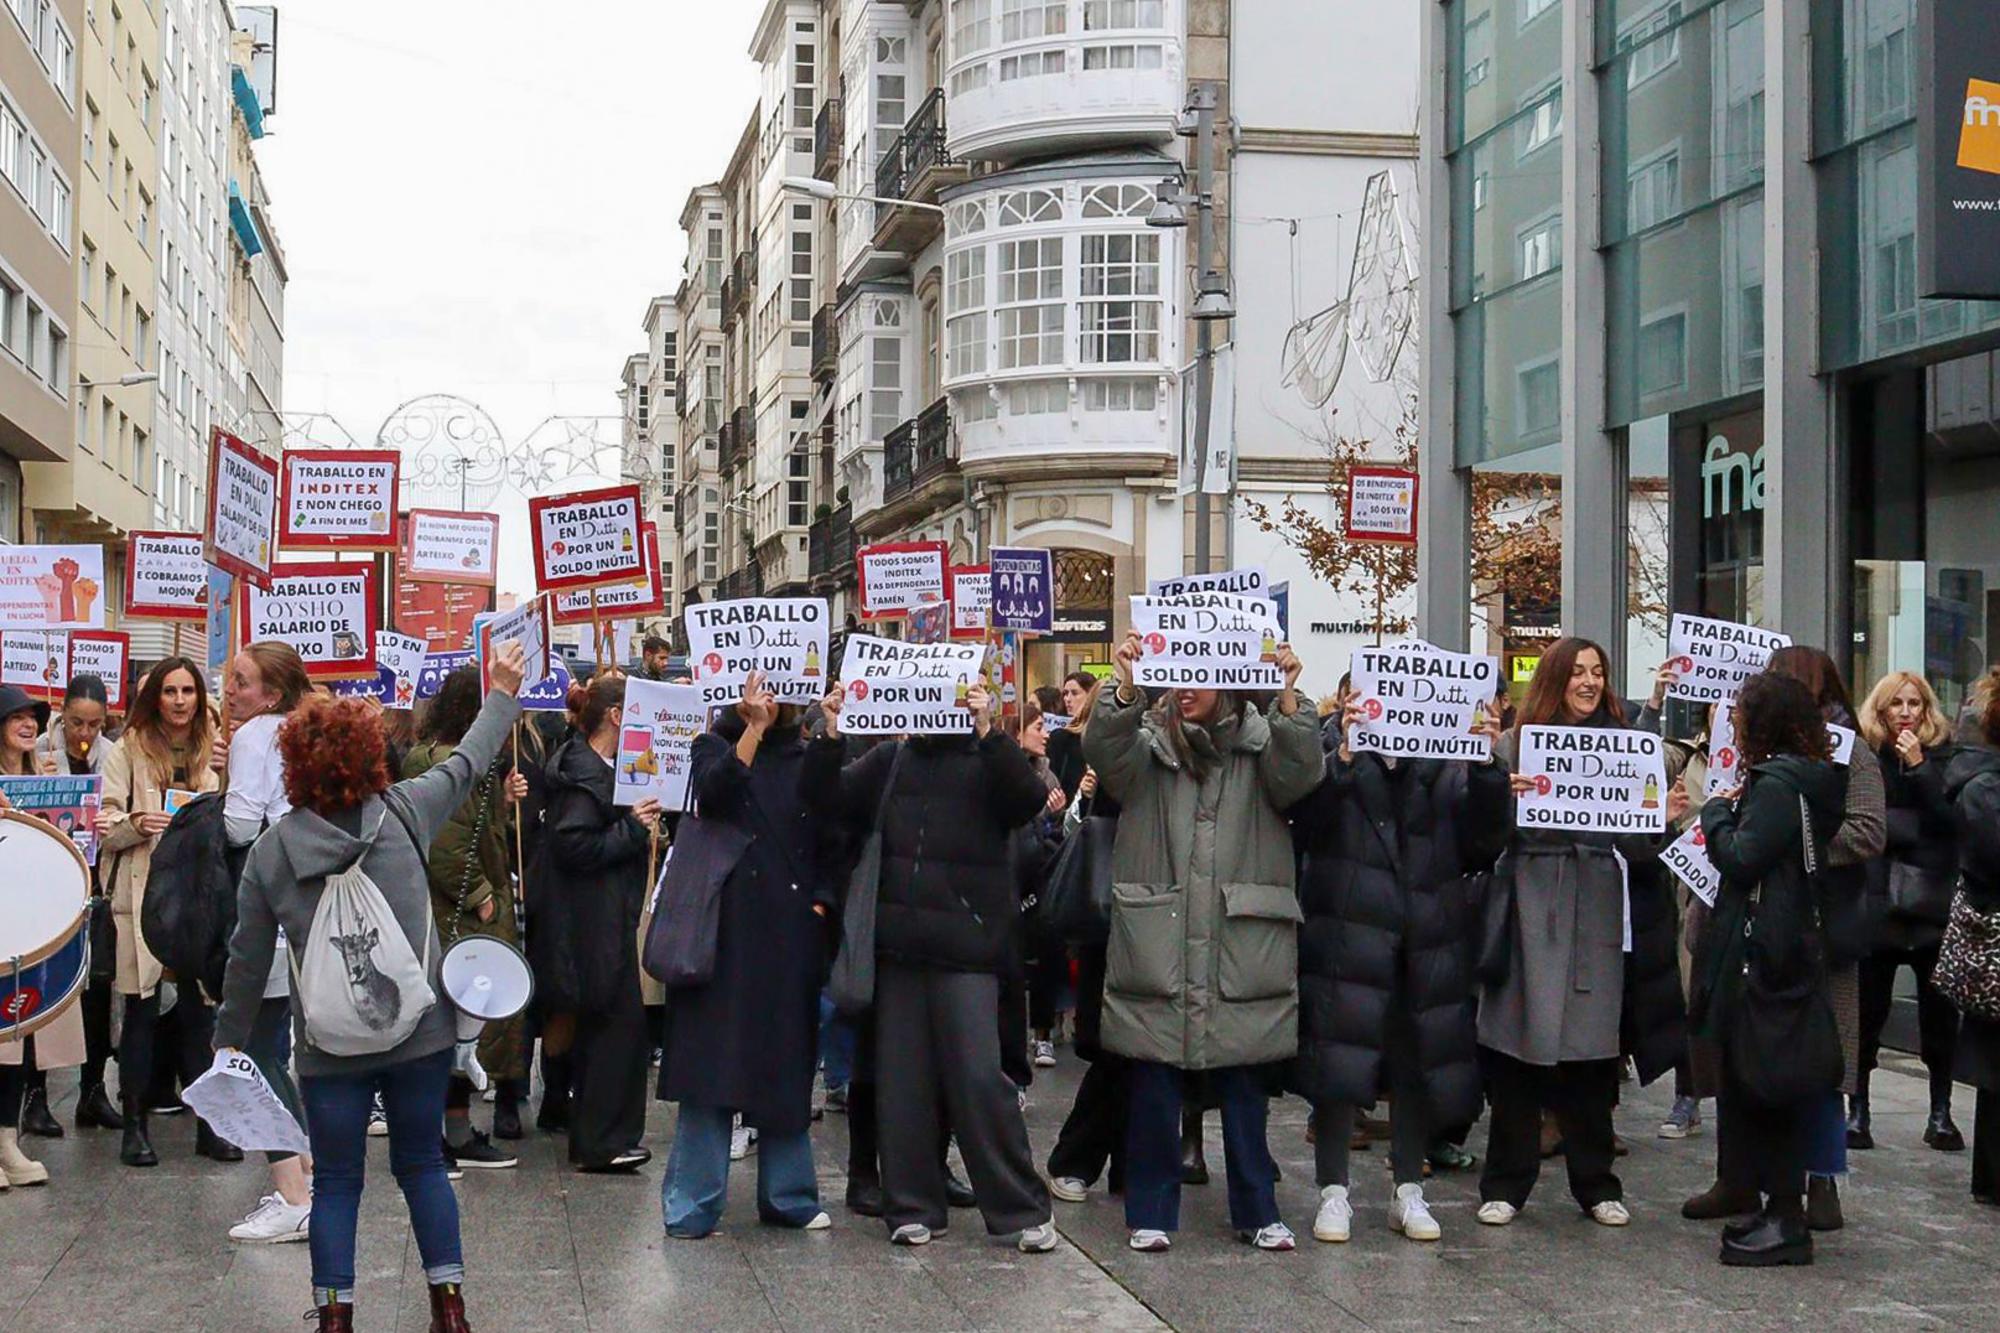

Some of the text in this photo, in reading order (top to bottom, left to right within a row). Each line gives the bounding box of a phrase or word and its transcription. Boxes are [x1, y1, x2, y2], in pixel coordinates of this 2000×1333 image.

[225, 457, 268, 495] TRABALLO
[299, 467, 385, 478] TRABALLO EN
[231, 483, 242, 503] EN
[300, 484, 378, 495] INDITEX
[1356, 492, 1365, 500] DE
[296, 501, 382, 510] E NON CHEGO
[548, 504, 628, 525] TRABALLO
[560, 522, 618, 539] EN Dutti
[140, 543, 200, 556] TRABALLO
[416, 550, 455, 560] ARTEIXO
[568, 540, 614, 555] POR UN
[552, 554, 636, 575] SOLDO INÚTIL
[869, 556, 935, 567] TODOS SOMOS
[137, 572, 142, 580] E
[145, 571, 202, 582] COBRAMOS
[885, 568, 922, 578] INDITEX
[958, 576, 980, 585] NON
[158, 584, 195, 597] MOJÓN
[341, 582, 361, 594] EN
[885, 579, 940, 589] DEPENDENTAS
[568, 591, 639, 606] INDCENTES
[872, 595, 905, 605] TAMÉN
[267, 600, 343, 617] OYSHO
[695, 604, 818, 628] TRABALLO
[259, 619, 350, 634] SALARIO DE
[1158, 610, 1256, 633] EN Dutti
[714, 625, 801, 649] EN Dutti
[1681, 620, 1783, 651] TRABALLO
[79, 643, 115, 654] SOMOS
[402, 640, 421, 653] EN
[856, 641, 975, 660] TRABALLO
[1171, 642, 1247, 657] POR UN
[1690, 642, 1764, 667] EN Dutti
[4, 661, 37, 672] ARTEIXO
[763, 657, 791, 671] UN
[865, 661, 951, 679] EN Dutti
[1363, 654, 1489, 680] TRABALLO
[1142, 665, 1281, 684] SOLDO INÚTIL
[1696, 665, 1728, 681] POR
[873, 688, 941, 702] POR UN
[1377, 679, 1470, 705] EN Dutti
[846, 710, 975, 728] SOLDO INÚTIL
[1386, 710, 1458, 727] POR UN
[1357, 732, 1486, 755] SOLDO INÚTIL
[1530, 731, 1655, 755] TRABALLO
[1545, 754, 1640, 779] EN Dutti
[1556, 784, 1629, 801] POR UN
[1526, 808, 1661, 828] SOLDO INÚTIL
[1665, 846, 1708, 893] SOLDO
